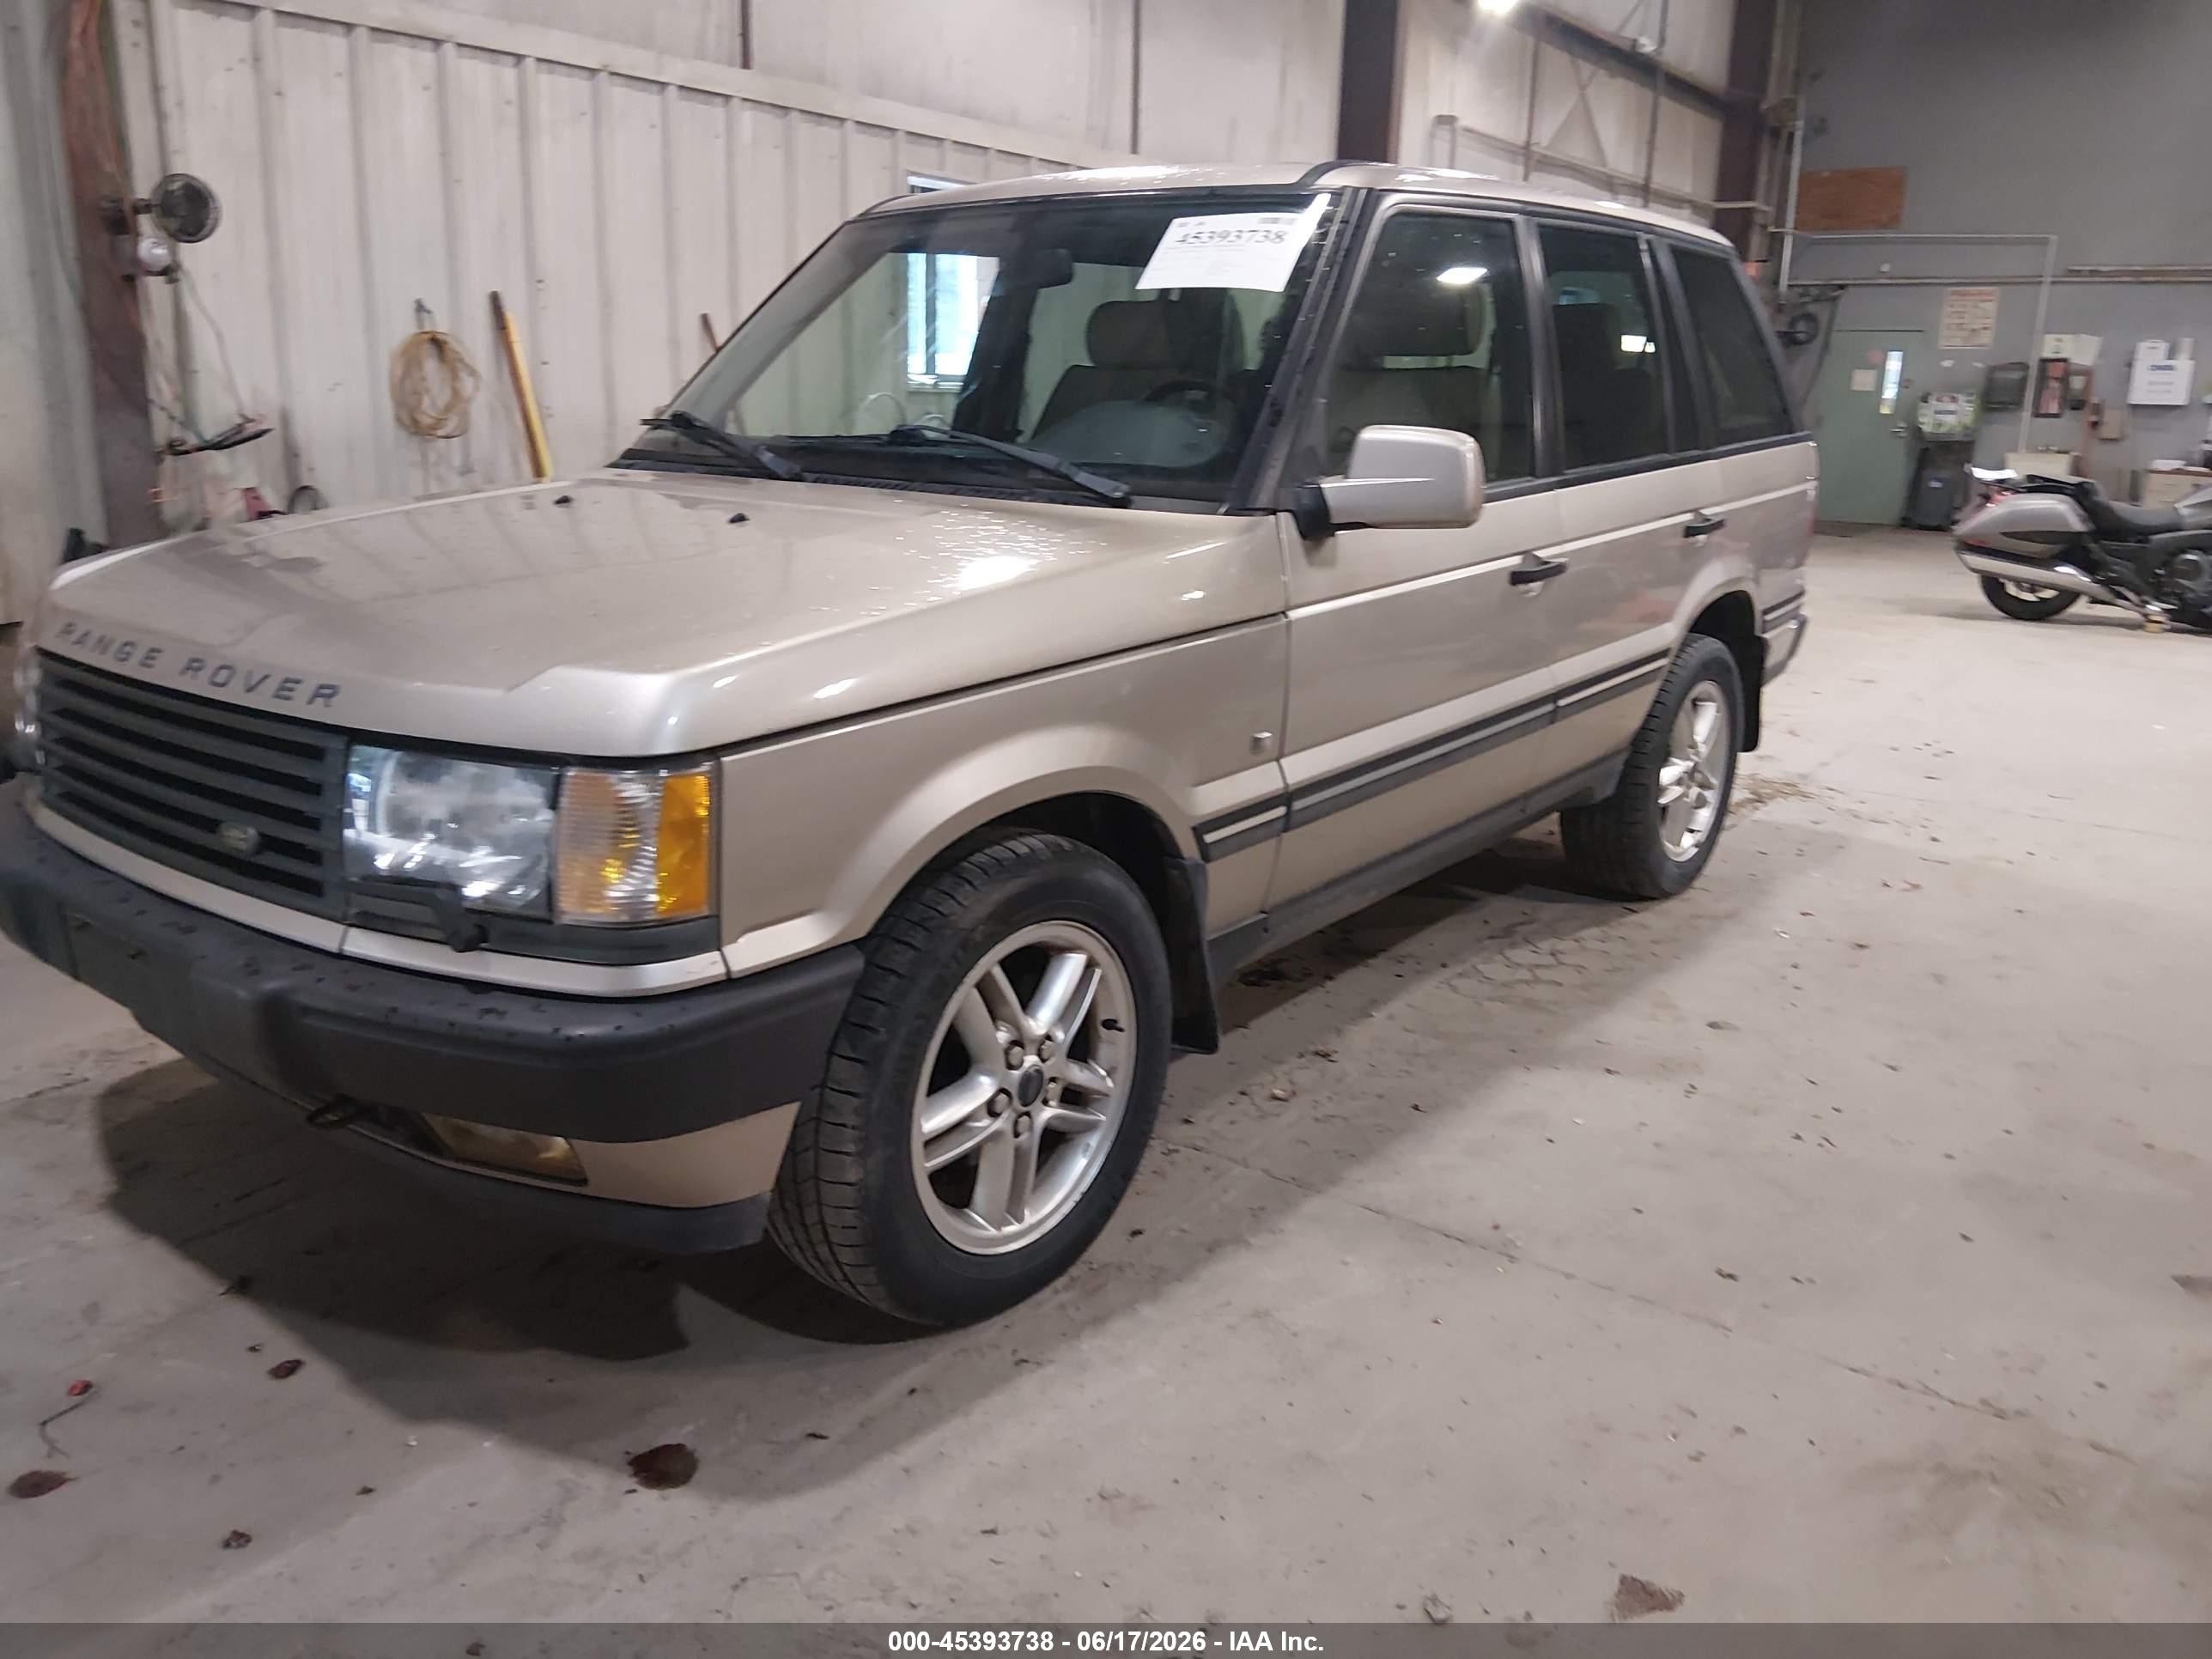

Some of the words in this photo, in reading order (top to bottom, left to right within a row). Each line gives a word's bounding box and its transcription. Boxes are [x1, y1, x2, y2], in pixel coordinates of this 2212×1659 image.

[1175, 229, 1288, 245] 45393738
[57, 622, 163, 669] RANGE
[179, 657, 342, 708] ROVER
